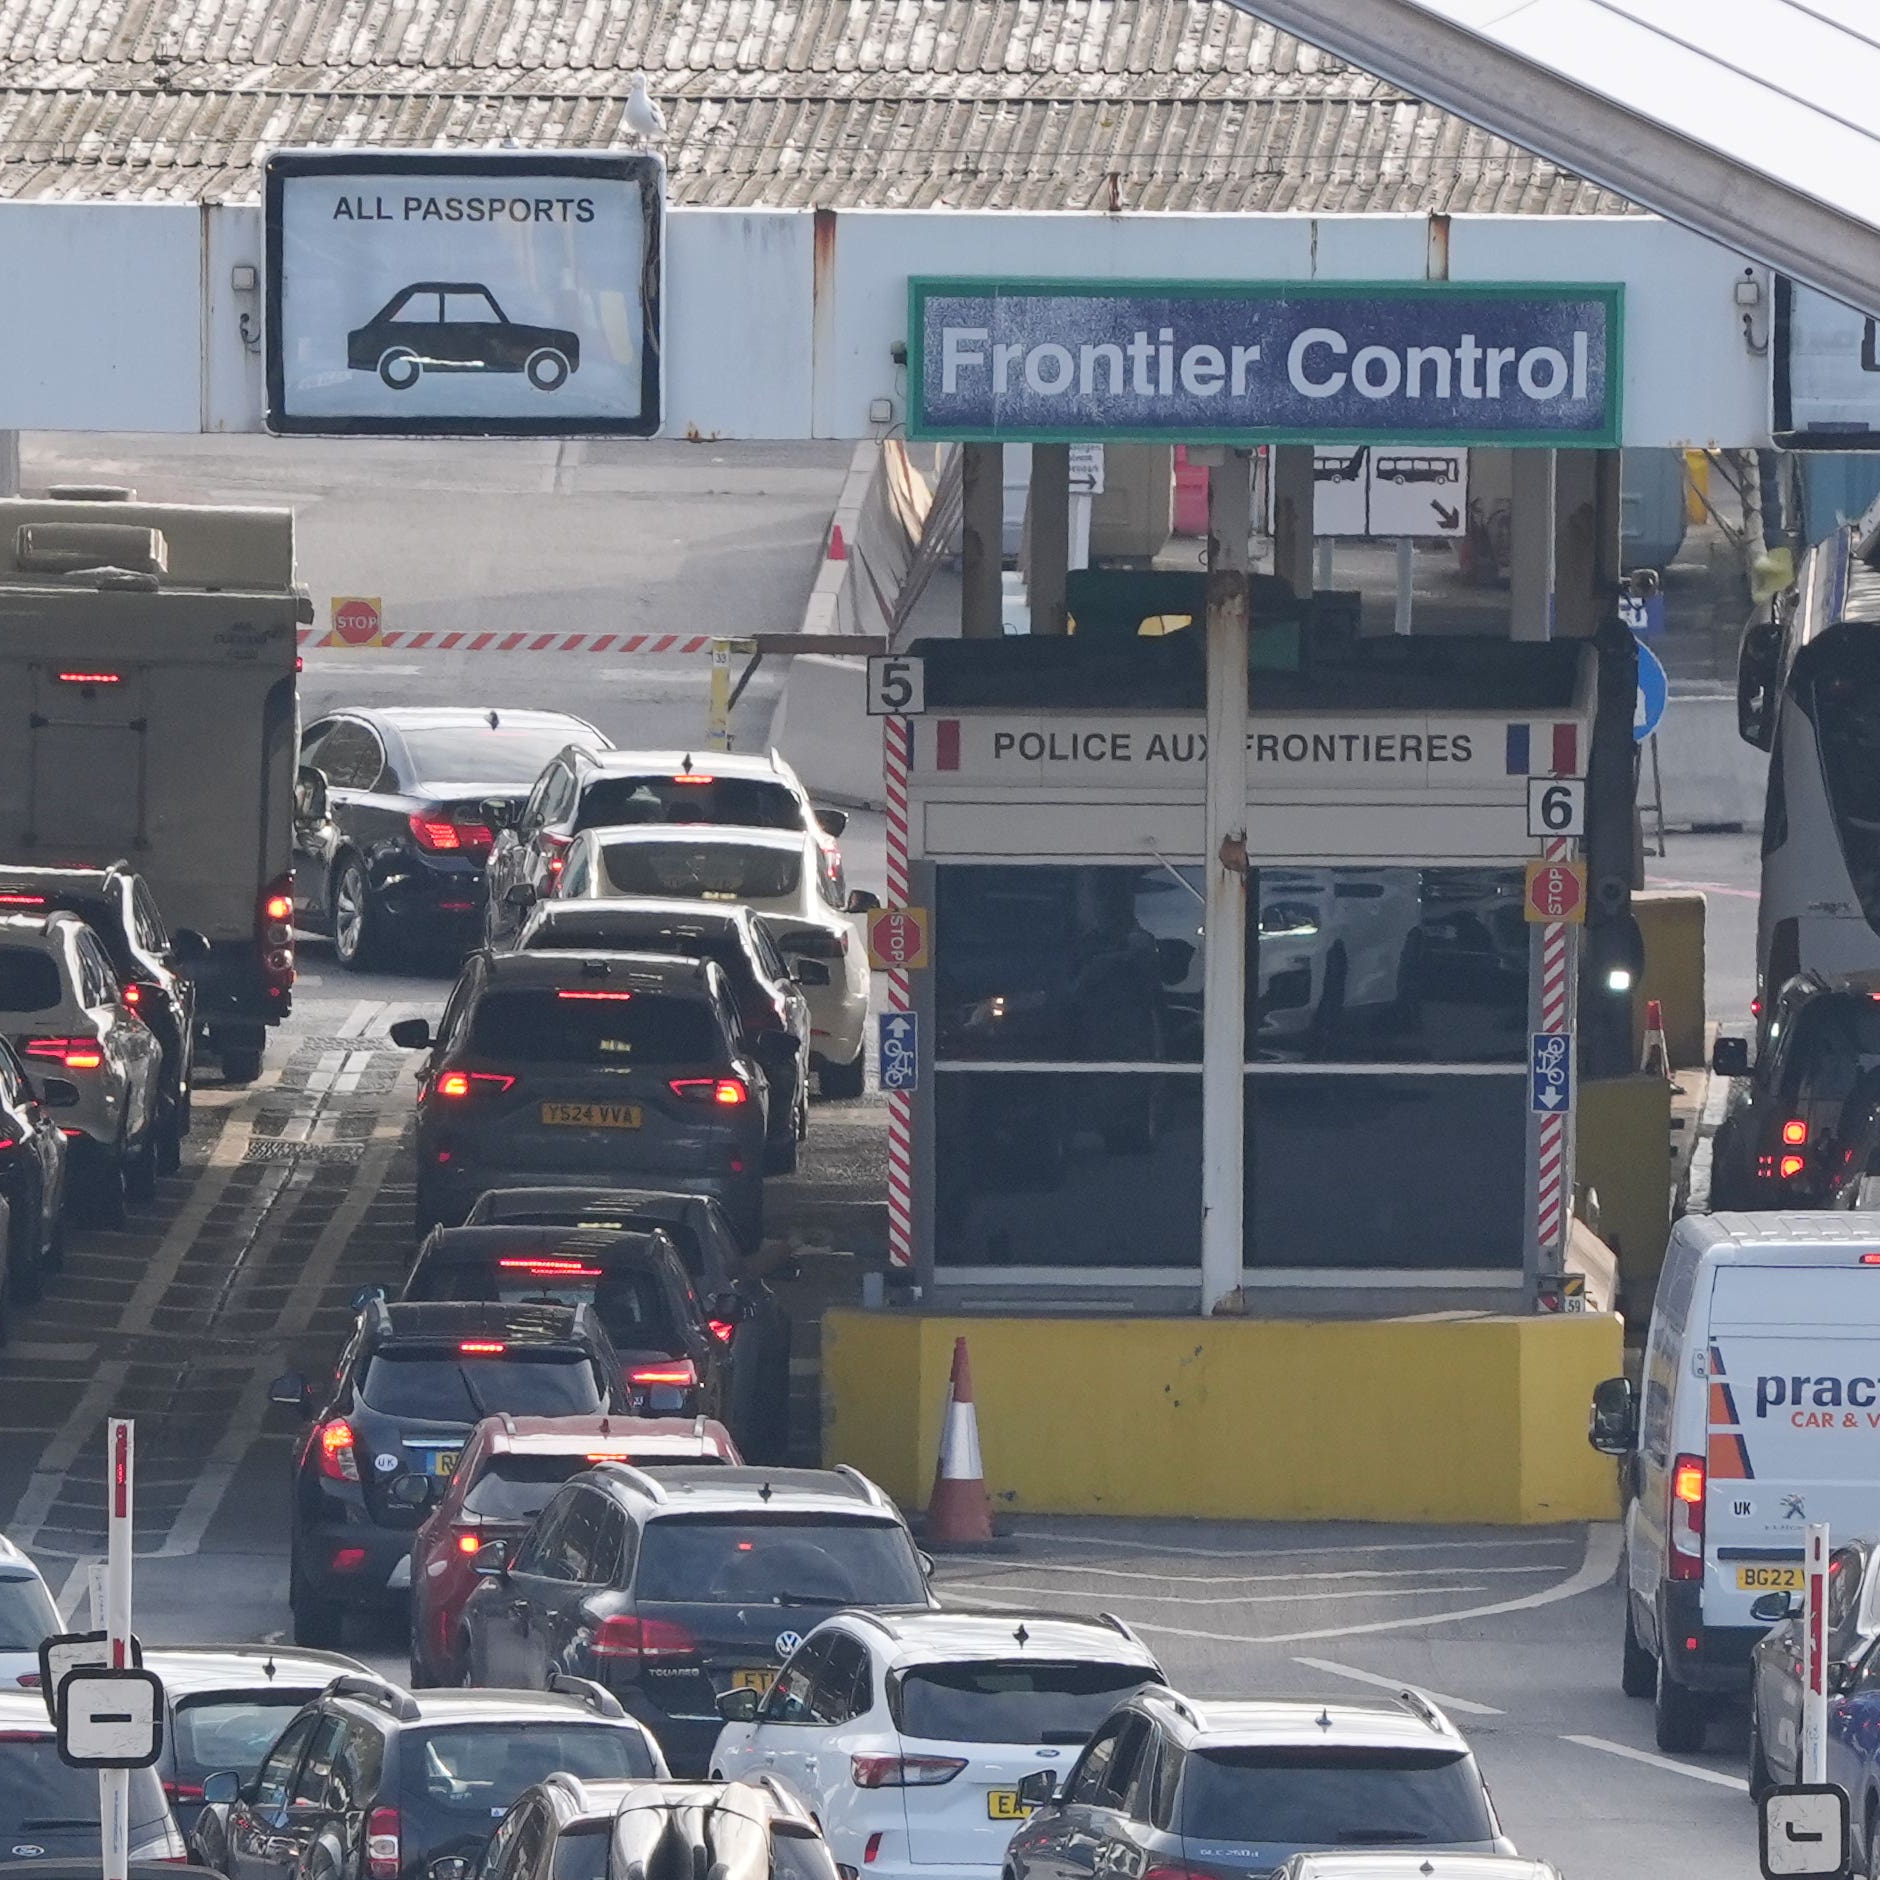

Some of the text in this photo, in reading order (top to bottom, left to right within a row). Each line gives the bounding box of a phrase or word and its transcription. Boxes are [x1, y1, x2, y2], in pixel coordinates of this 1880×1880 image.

[332, 197, 595, 223] ALL PASSPORTS
[942, 326, 1587, 401] Frontier Control
[337, 616, 377, 630] STOP
[880, 664, 913, 708] 5
[993, 732, 1132, 763] POLICE
[1246, 734, 1473, 764] RONTIERES
[1541, 786, 1573, 830] 6
[1549, 868, 1563, 915] STOP
[890, 914, 905, 962] STOP
[1791, 1411, 1836, 1430] CAR
[1842, 1411, 1858, 1431] &
[378, 1458, 394, 1468] UK
[1733, 1501, 1751, 1516] UK
[1745, 1567, 1795, 1588] BG22
[1785, 1821, 1822, 1842] J
